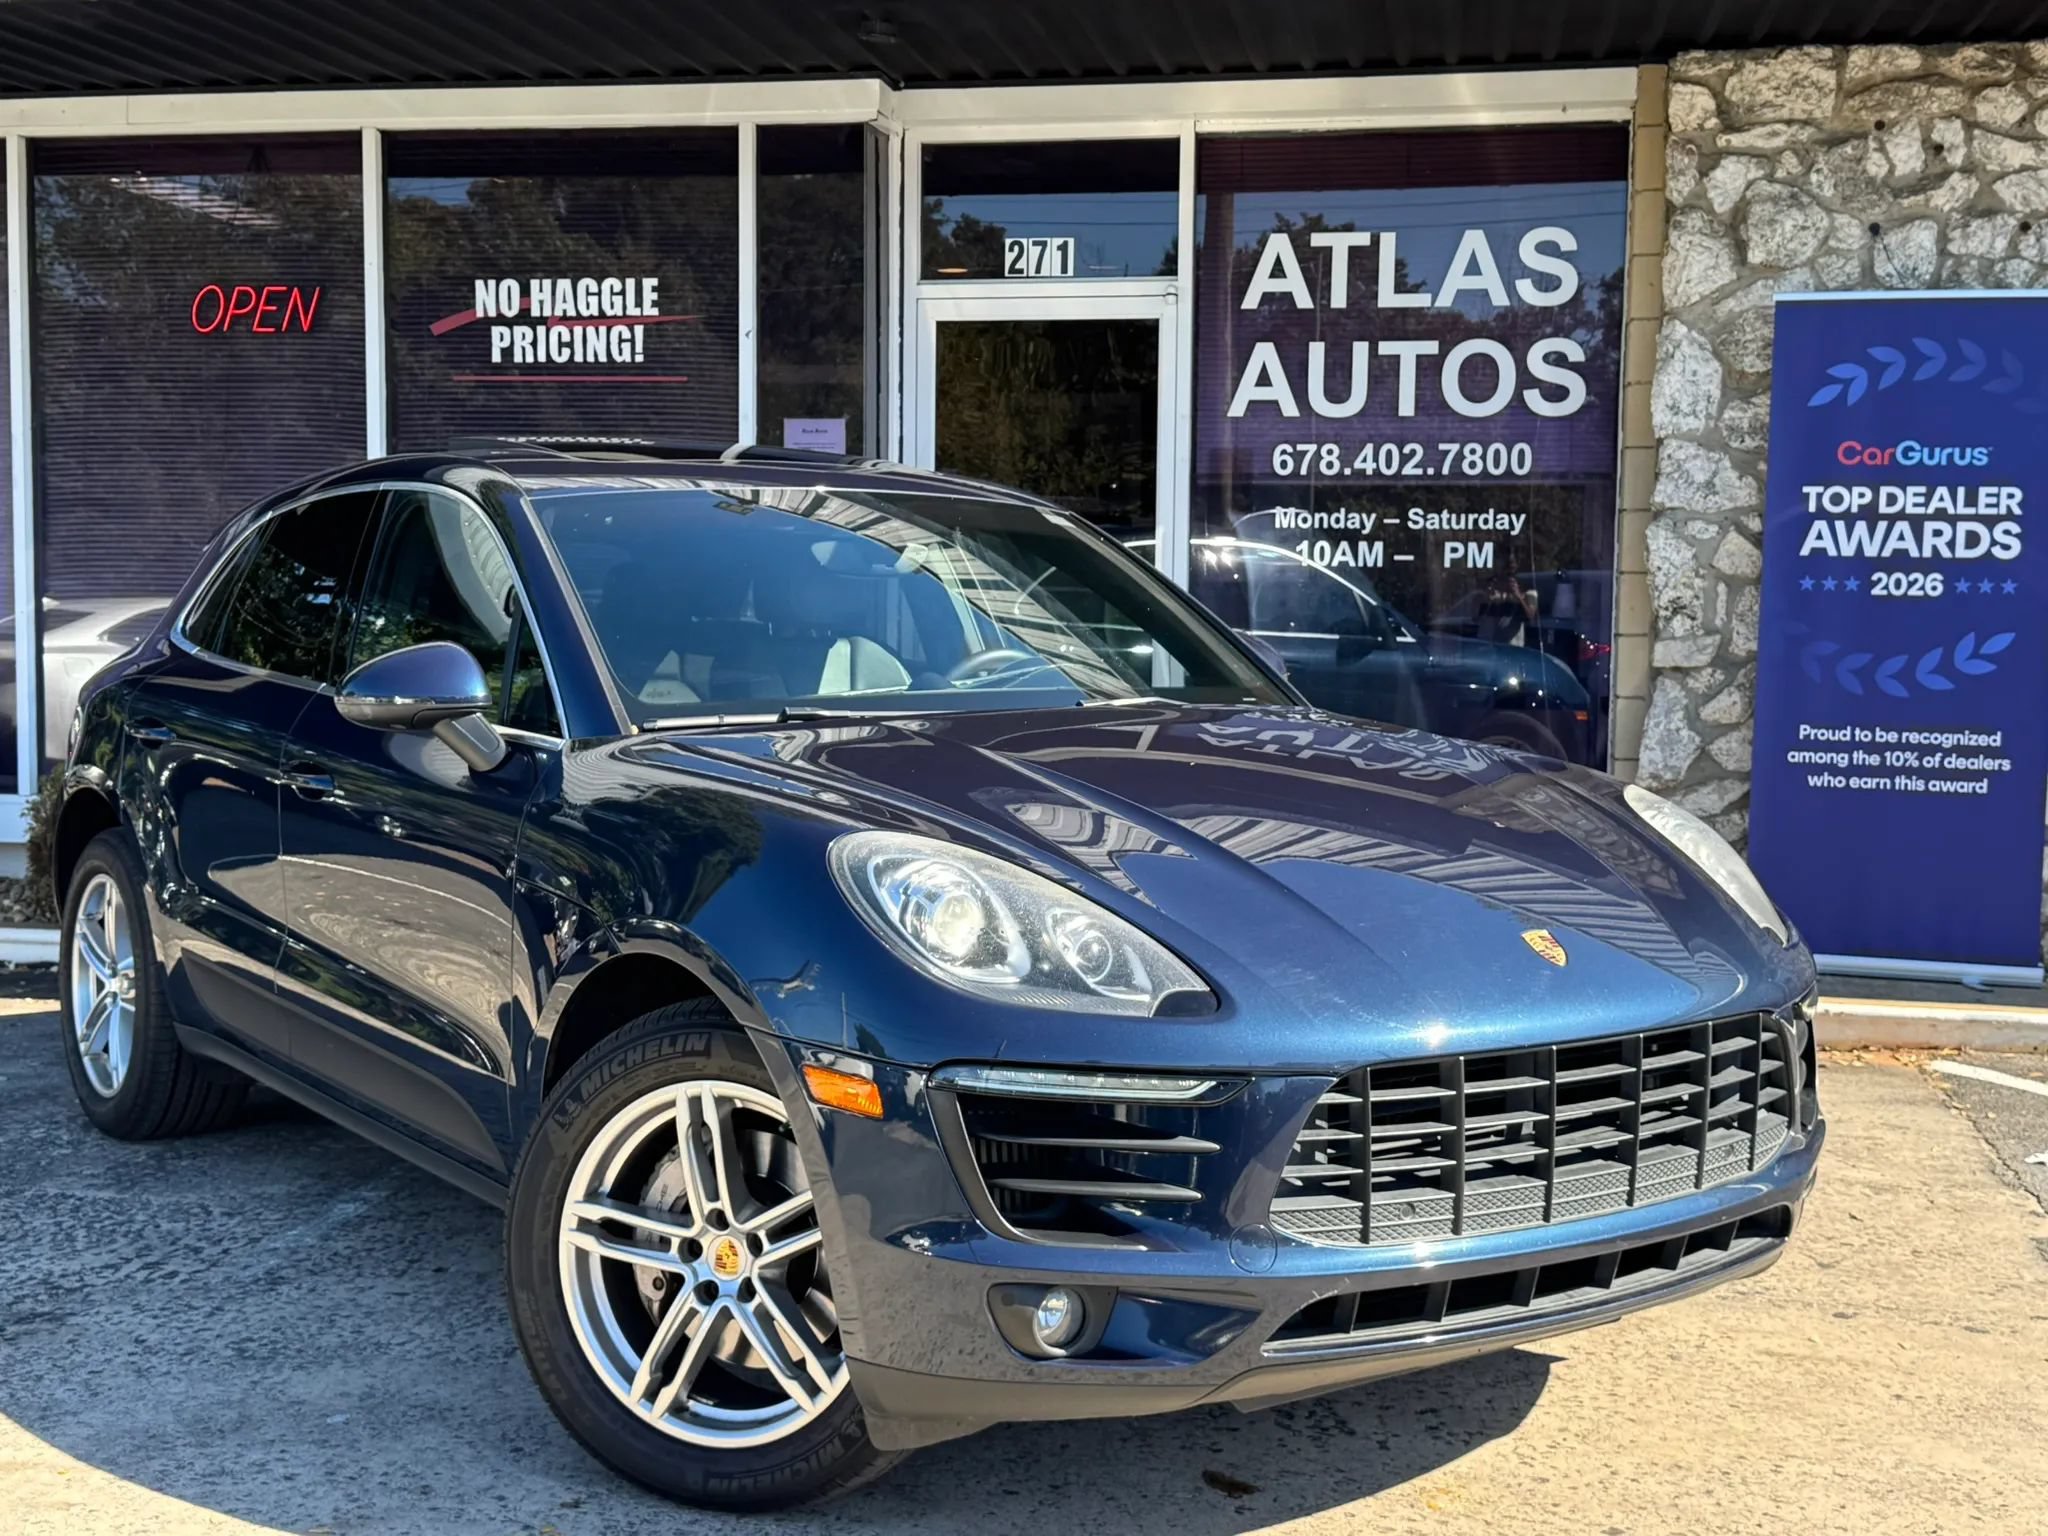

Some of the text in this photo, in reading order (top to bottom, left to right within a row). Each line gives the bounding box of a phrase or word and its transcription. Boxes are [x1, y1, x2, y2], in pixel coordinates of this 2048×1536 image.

[1008, 240, 1069, 275] 271
[1240, 226, 1579, 310] ATLAS
[191, 284, 320, 333] OPEN
[475, 277, 660, 317] NO HAGGLE
[491, 325, 645, 363] PRICING!
[1227, 338, 1588, 418] AUTOS
[1272, 442, 1533, 476] 678.402.7800
[1837, 440, 1989, 466] CarGurus
[1802, 485, 2023, 516] TOP DEALER
[1274, 506, 1377, 535] Monday
[1407, 507, 1526, 536] Saturday
[1296, 540, 1385, 568] 10AM
[1443, 541, 1494, 569] PM
[1799, 519, 2023, 560] AWARDS
[1870, 571, 1944, 597] 2026
[1799, 724, 2003, 749] Proud to be recognized
[1787, 749, 2012, 772] among the 10% of dealers
[1807, 772, 1989, 794] who earn this award
[580, 1032, 711, 1100] MICHELIN
